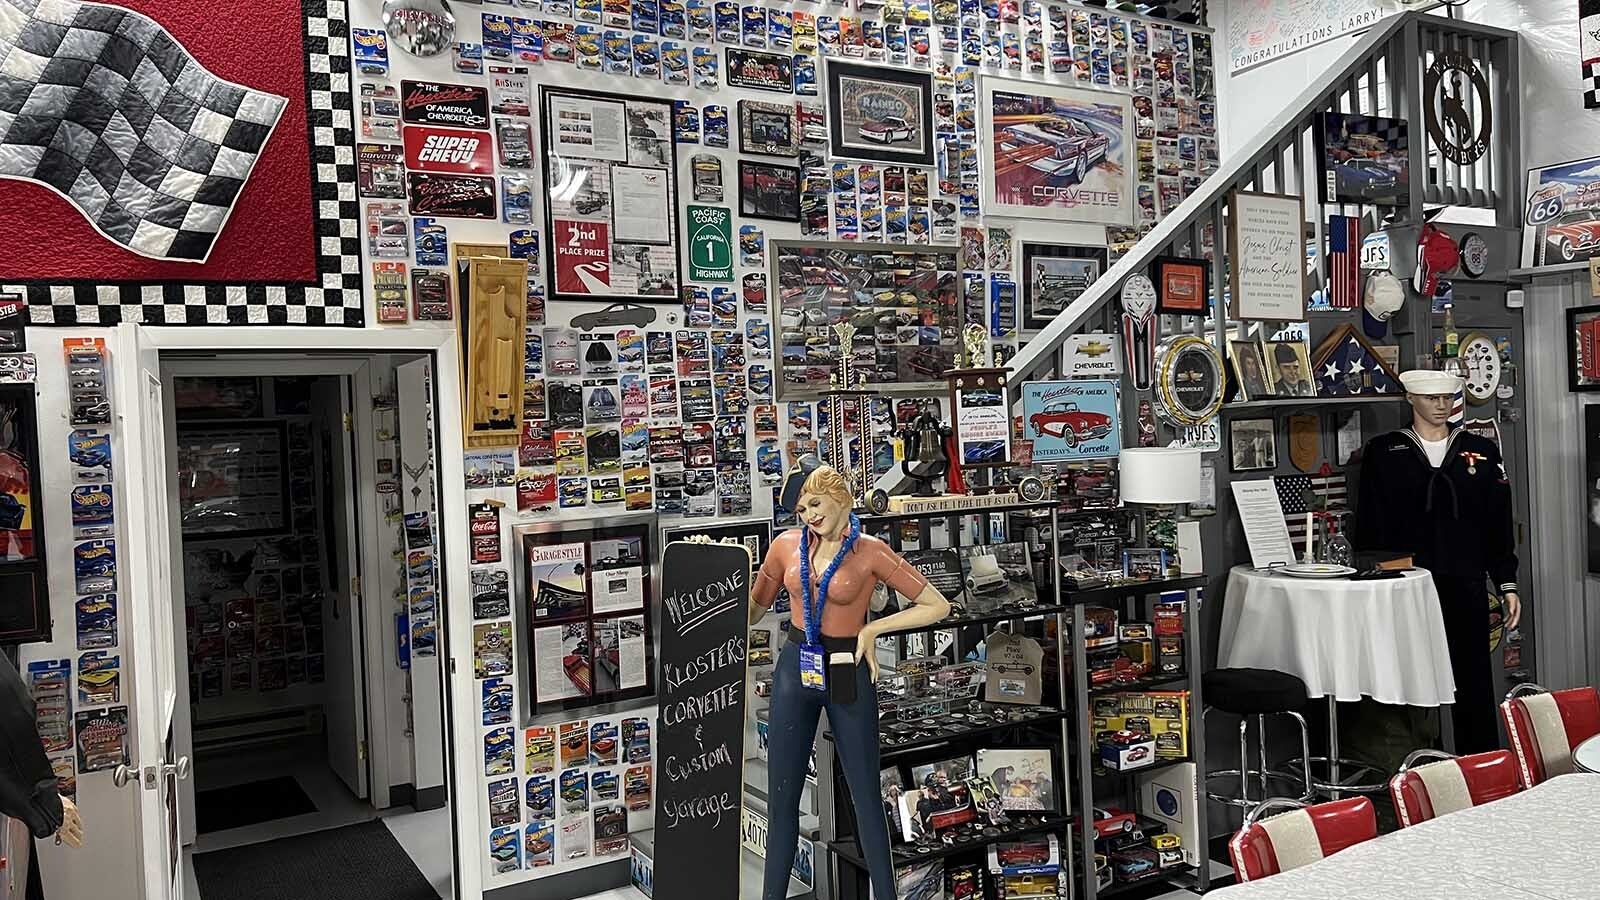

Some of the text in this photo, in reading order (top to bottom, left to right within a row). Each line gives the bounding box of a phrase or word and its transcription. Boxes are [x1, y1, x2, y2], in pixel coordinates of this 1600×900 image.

[1234, 7, 1384, 68] CONGRATULATIONS LARRY!
[425, 84, 440, 92] THE
[427, 112, 468, 122] CHEVROLET
[437, 105, 473, 115] AMERICA
[424, 135, 480, 151] SUPER
[766, 144, 777, 152] 66
[418, 148, 475, 164] CHEVY
[1032, 185, 1119, 203] CORVETTE
[692, 209, 726, 219] PACIFIC
[1534, 198, 1559, 220] 66
[696, 216, 724, 225] COAST
[568, 227, 596, 247] 2nd
[697, 234, 724, 243] CALIFORNIA
[560, 247, 606, 257] PLACE PRIZE
[706, 241, 714, 262] 1
[1363, 246, 1385, 263] JFS
[696, 269, 729, 278] HIGHWAY
[1074, 361, 1114, 370] CHEVROLET
[1079, 444, 1110, 454] Corvette
[665, 569, 744, 624] WELCOME
[664, 635, 746, 694] KLOSTER'S
[663, 680, 742, 726] CORVETTE
[665, 742, 733, 782] Custom
